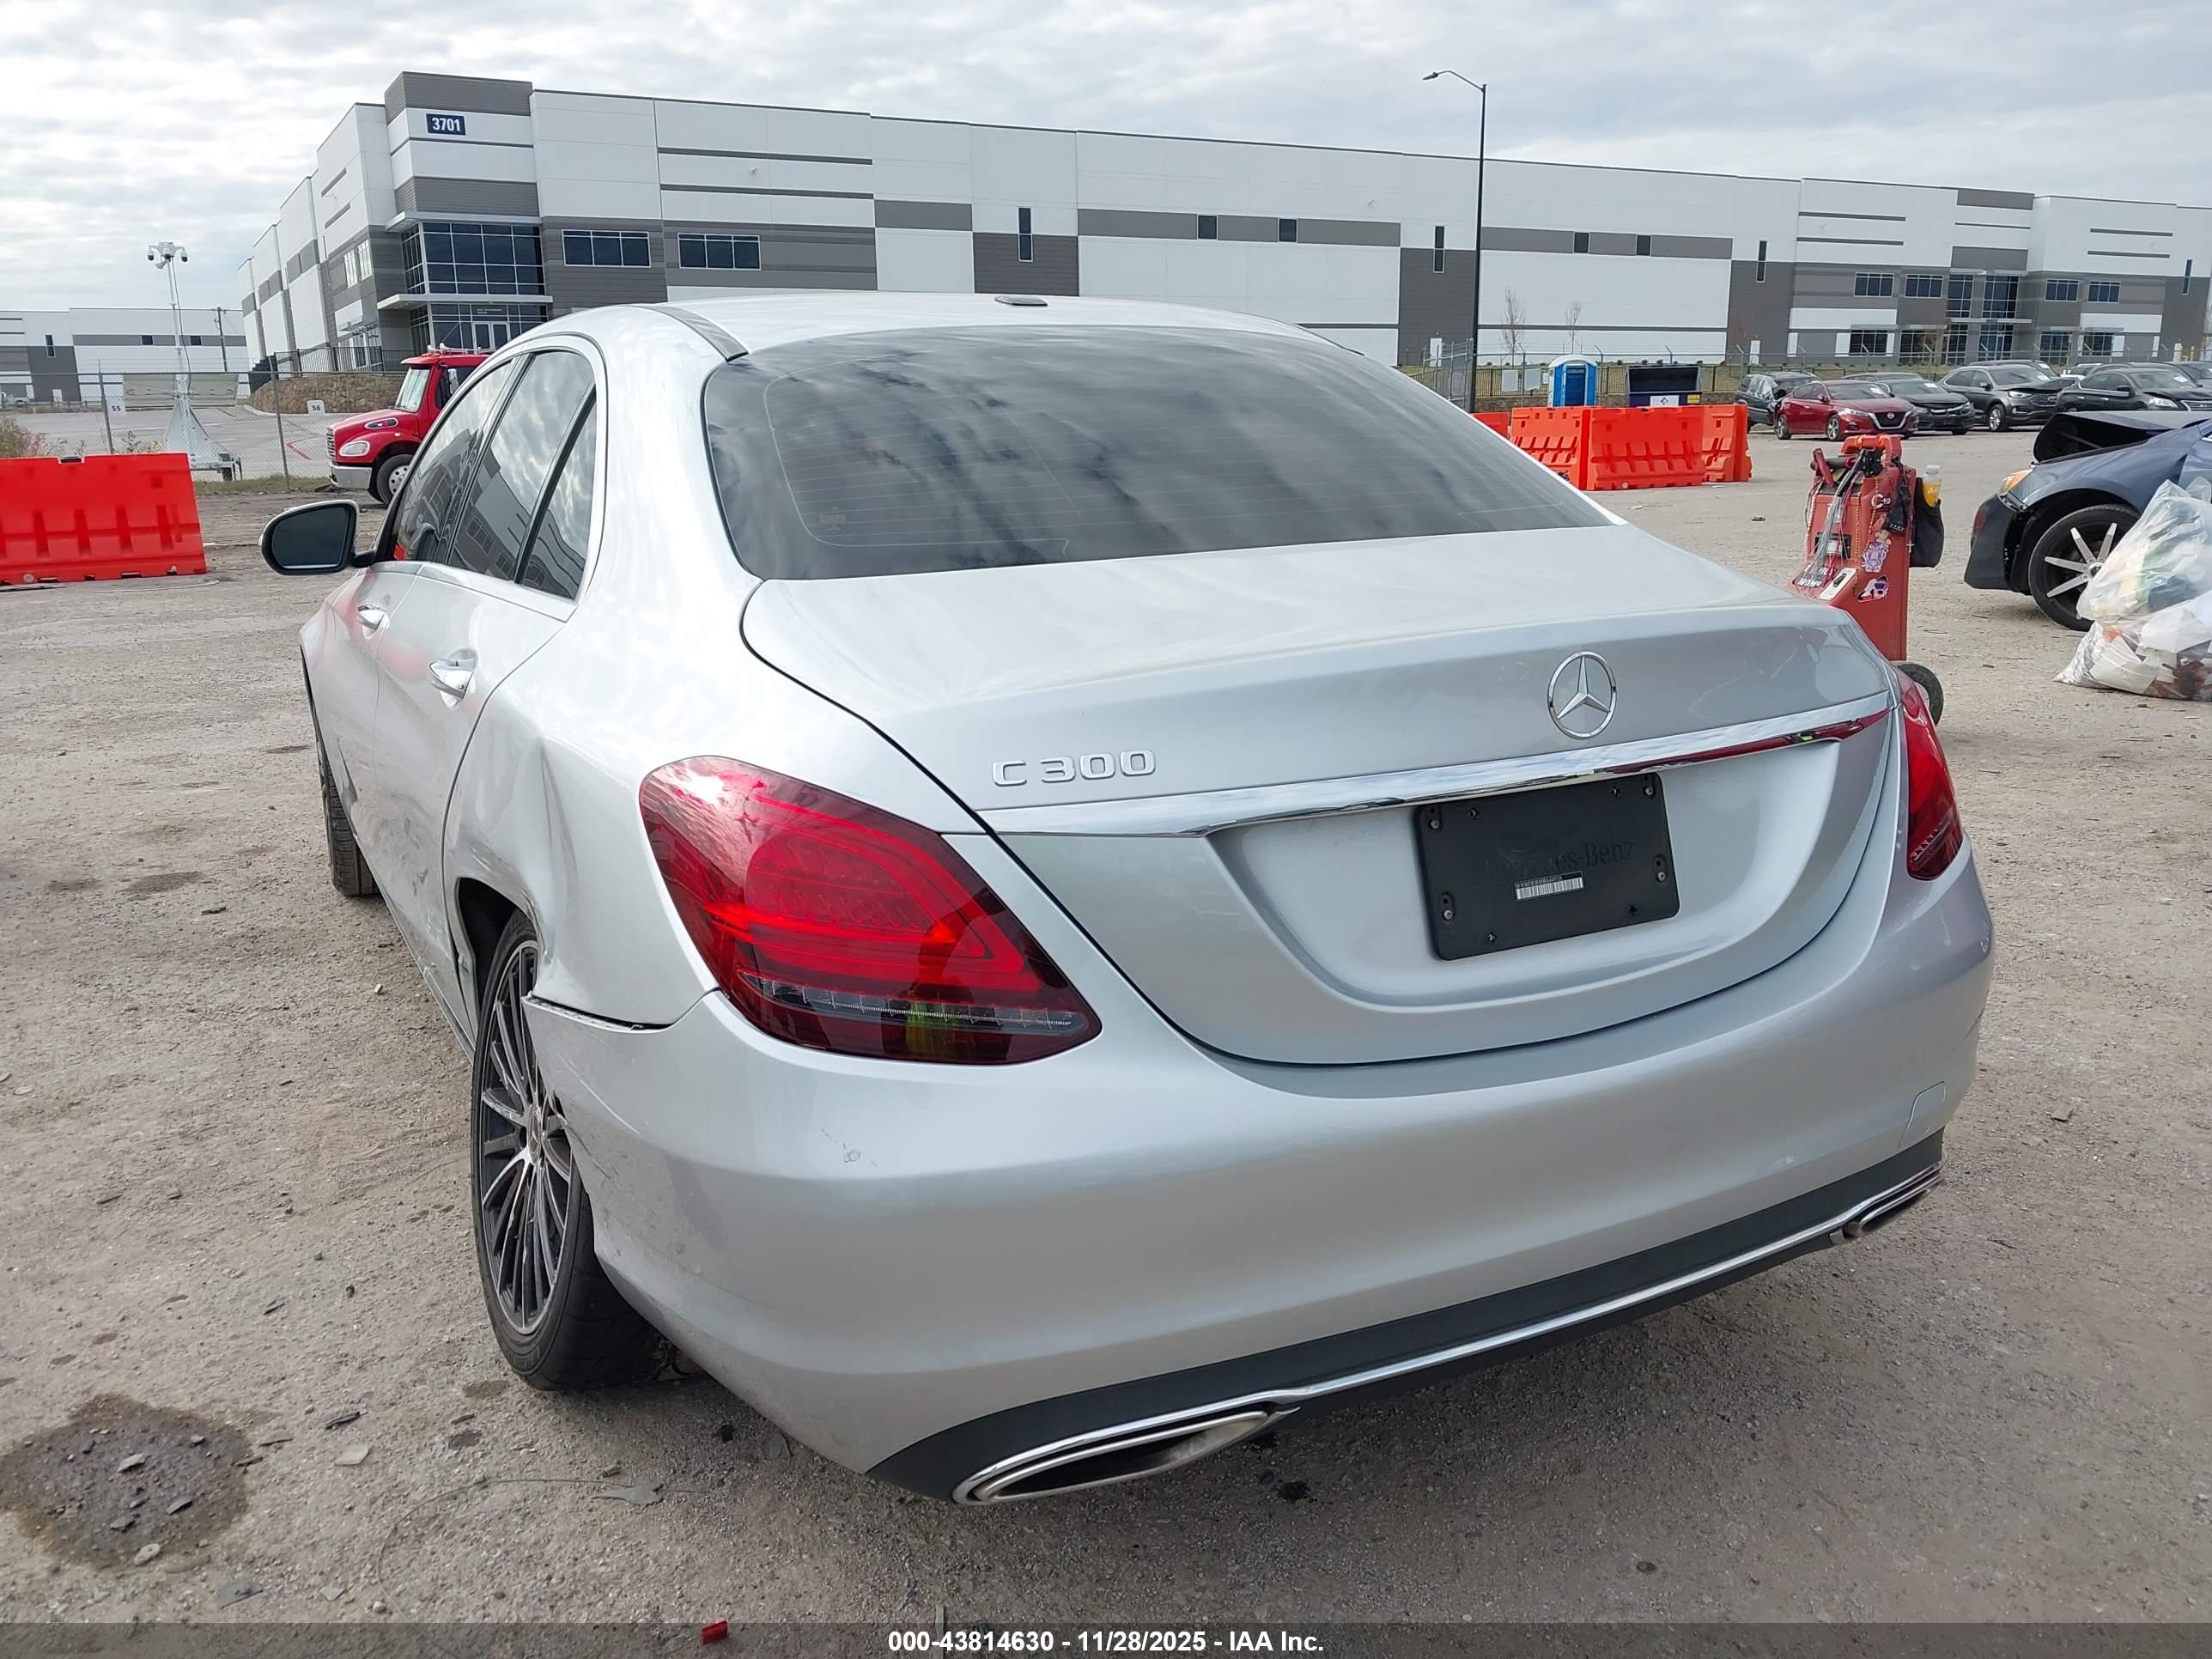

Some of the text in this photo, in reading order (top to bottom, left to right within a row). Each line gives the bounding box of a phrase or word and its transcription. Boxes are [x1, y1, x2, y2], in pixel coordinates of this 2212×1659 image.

[431, 117, 461, 132] 3701
[992, 750, 1156, 787] C 300
